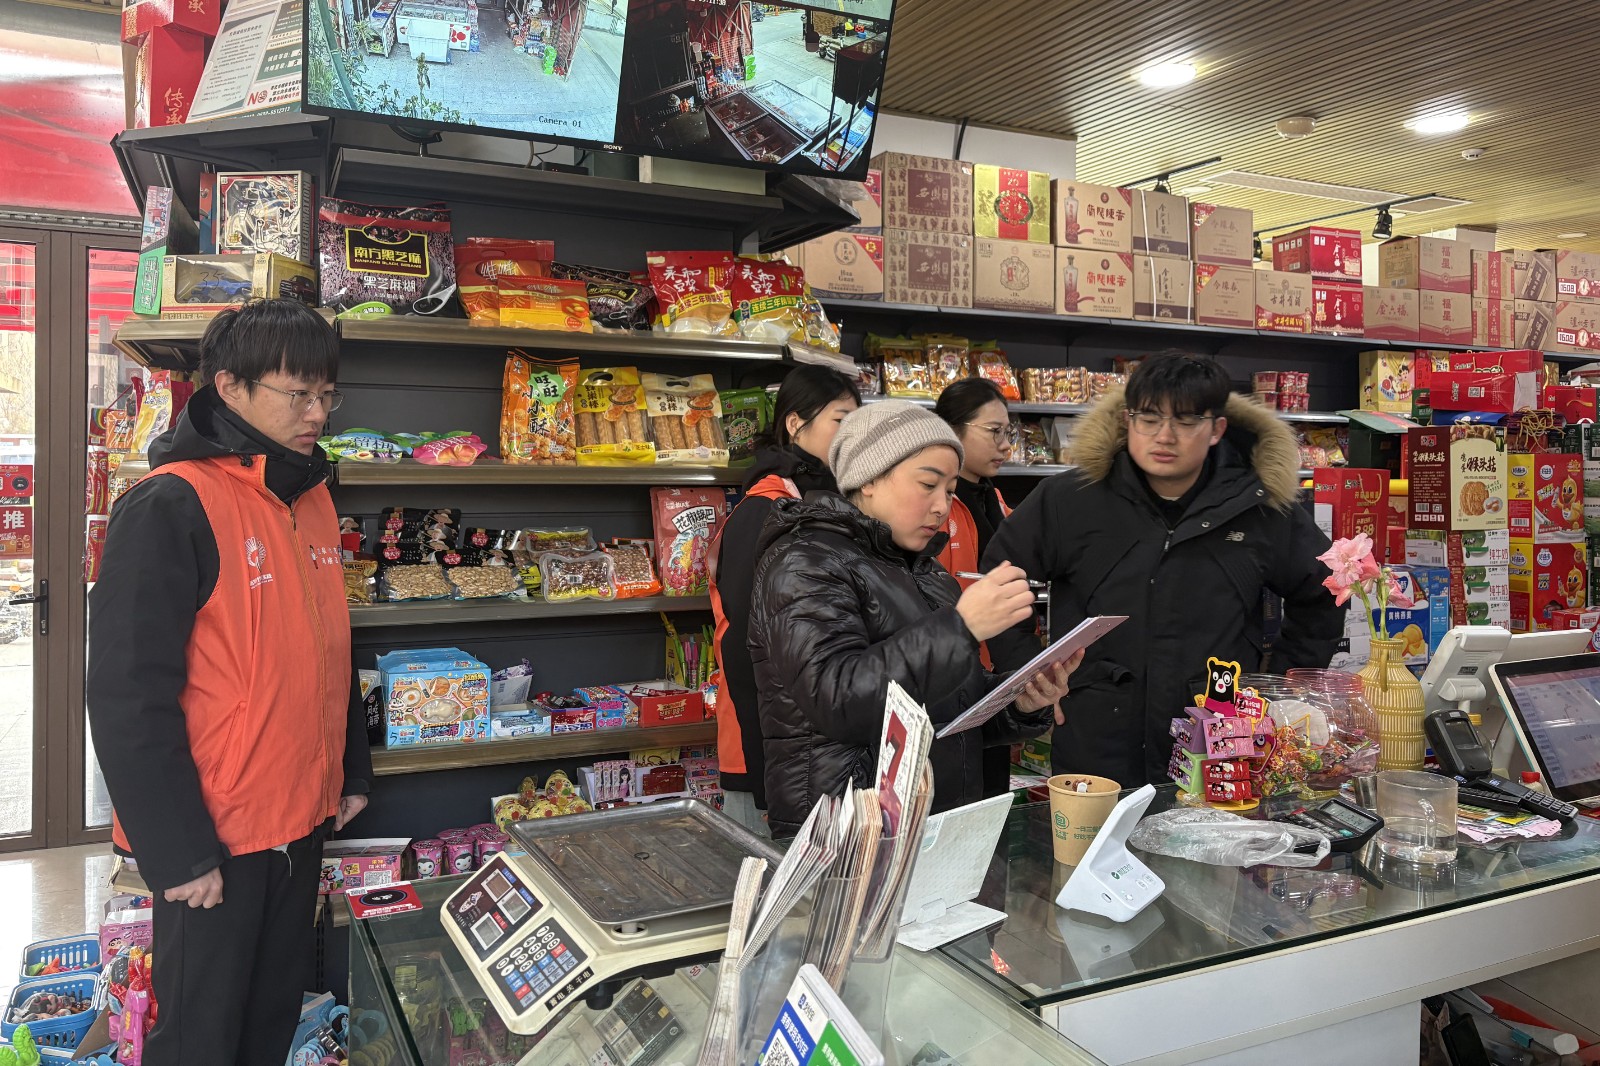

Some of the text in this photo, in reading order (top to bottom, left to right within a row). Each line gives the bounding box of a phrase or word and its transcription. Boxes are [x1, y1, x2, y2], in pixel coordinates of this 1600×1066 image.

[539, 115, 581, 128] Camera 01
[1099, 228, 1114, 238] XO
[354, 246, 422, 264] 南方黑芝麻
[1441, 245, 1452, 270] 福星
[663, 265, 702, 282] 永和
[741, 264, 777, 283] 永和
[1489, 257, 1500, 288] 金六福
[1099, 296, 1114, 304] XO
[1376, 299, 1409, 318] 金六福
[1442, 298, 1453, 322] 福星
[1489, 304, 1500, 336] 金六福
[534, 374, 561, 398] 旺旺
[1418, 452, 1446, 463] 猴头菇
[1467, 456, 1497, 473] 猴头菇
[3, 510, 26, 530] 推
[675, 508, 715, 530] 花椒锅巴
[1489, 548, 1508, 561] 纯牛奶
[1489, 585, 1508, 596] 纯牛奶
[420, 724, 460, 739] 满汉全席
